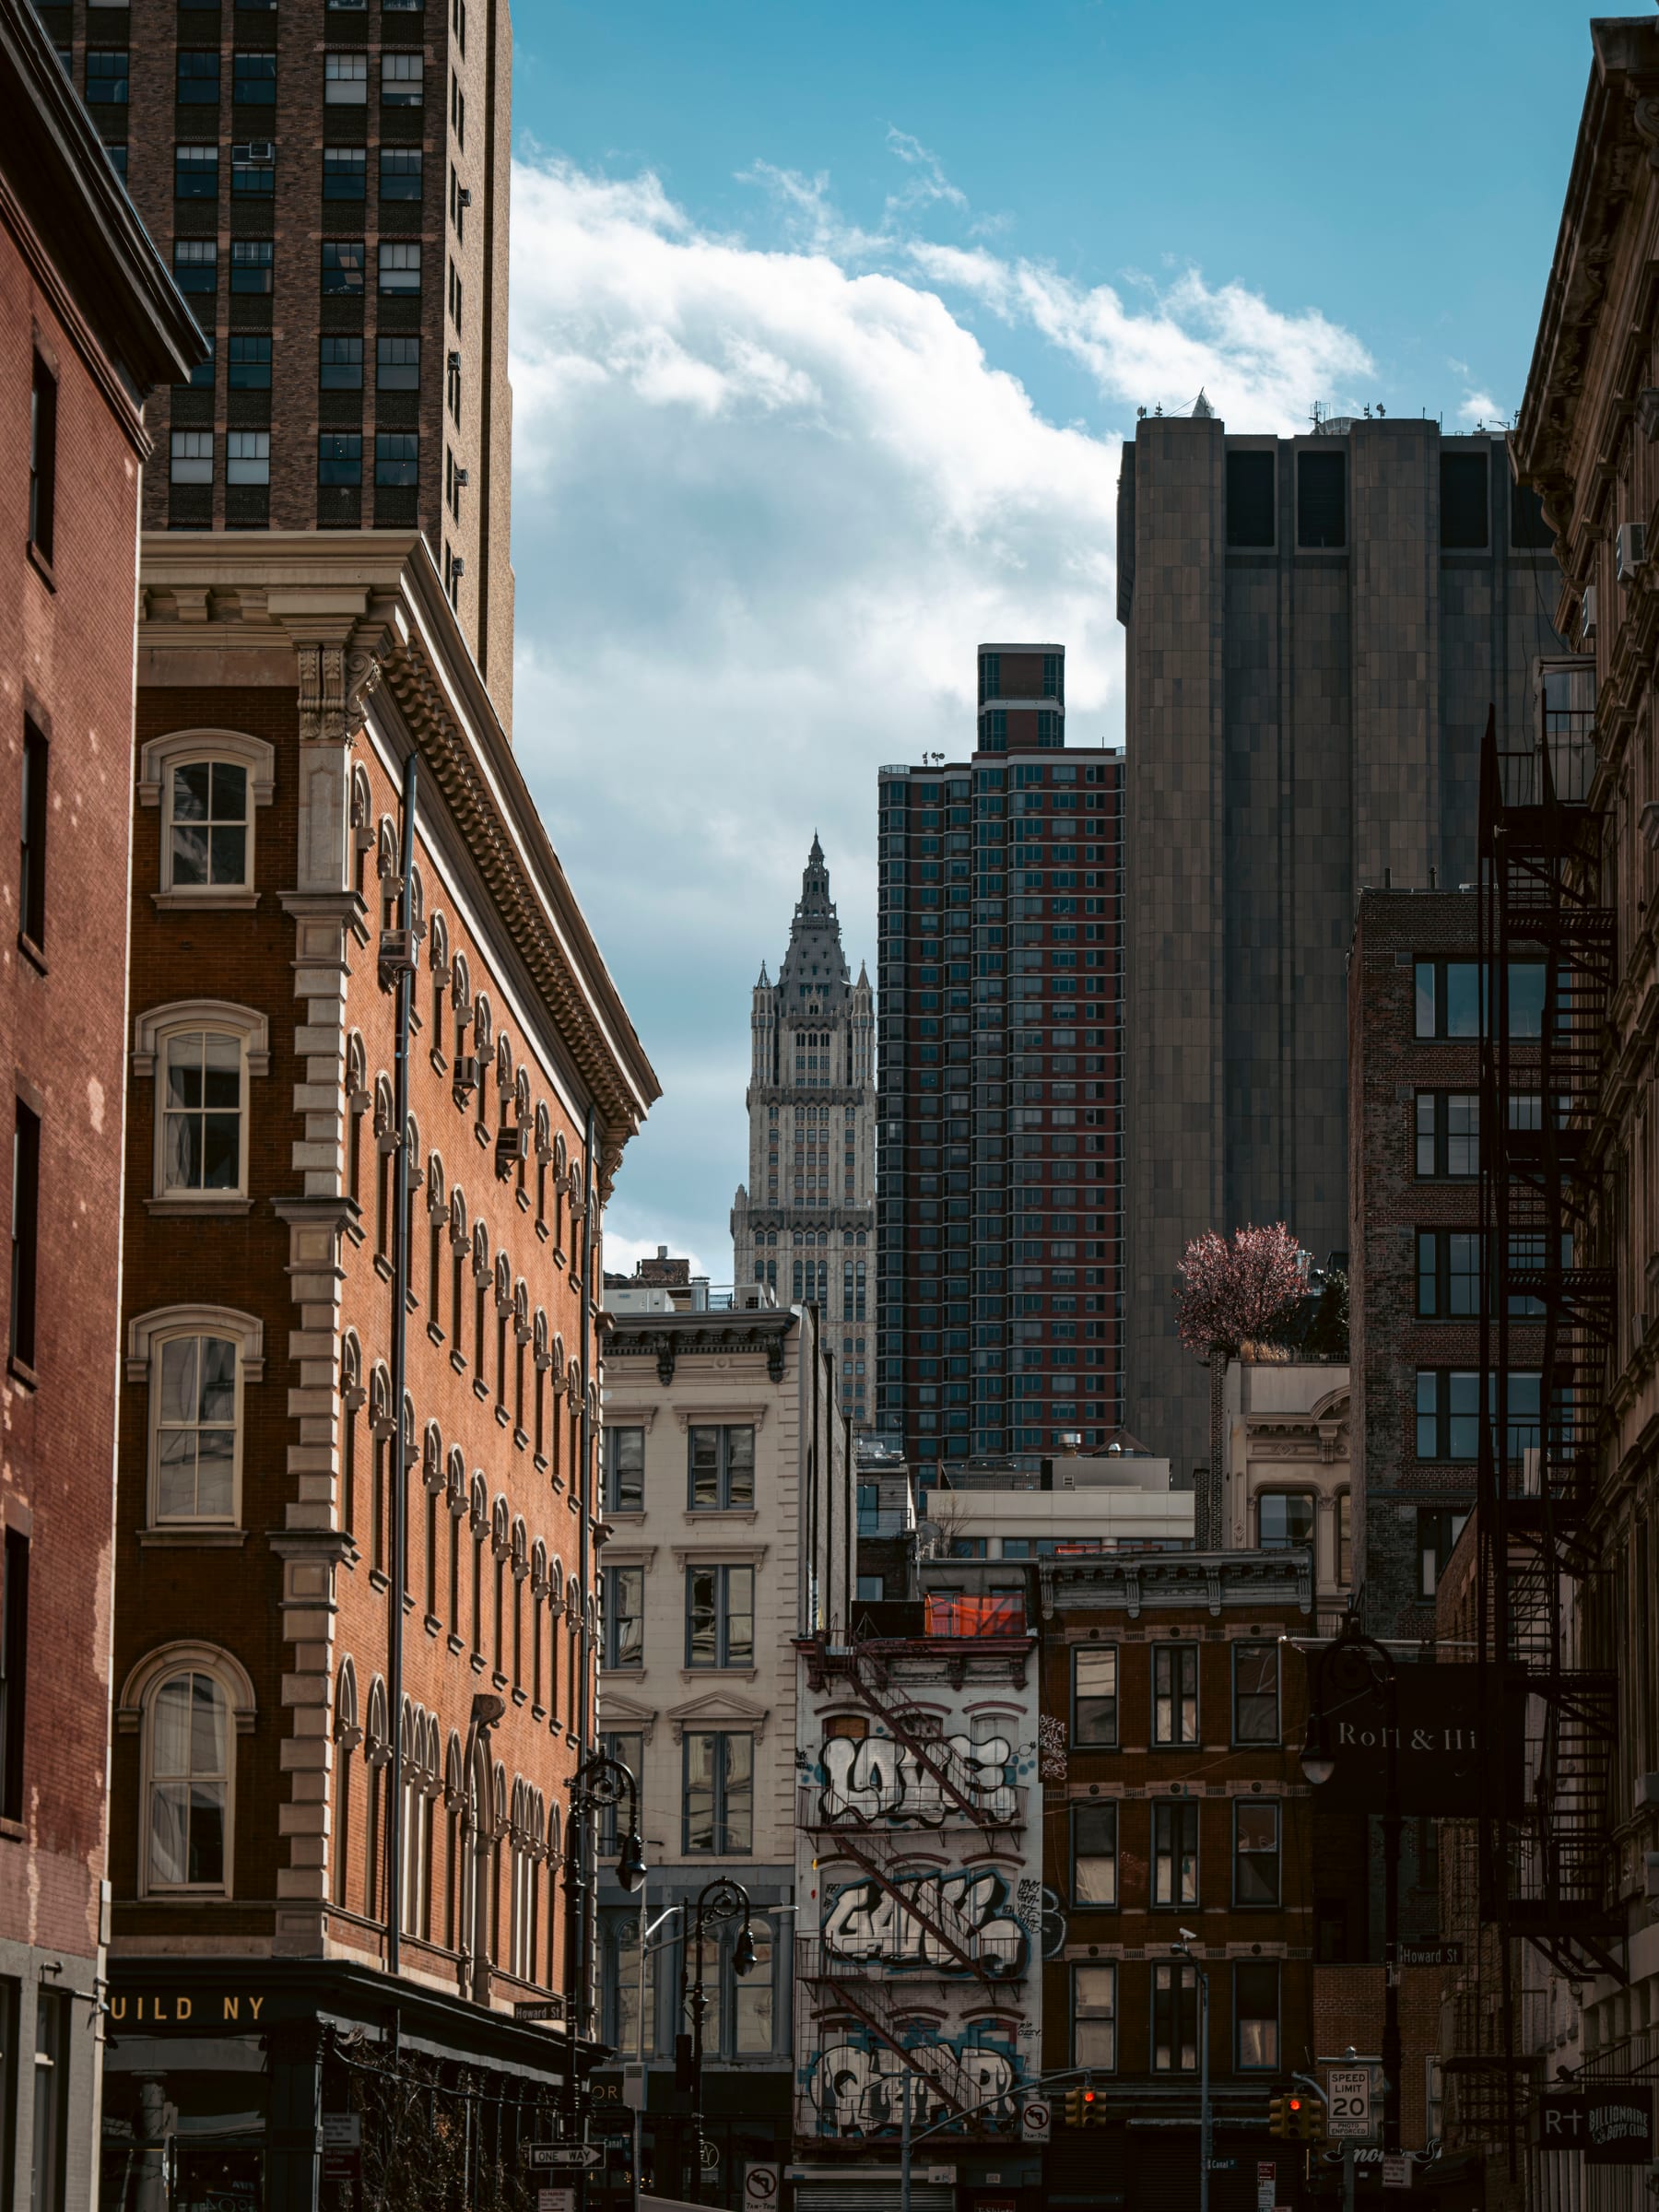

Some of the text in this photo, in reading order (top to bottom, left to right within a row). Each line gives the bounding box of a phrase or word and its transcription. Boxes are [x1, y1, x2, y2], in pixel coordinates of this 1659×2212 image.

[1410, 1728, 1438, 1751] &
[1403, 1947, 1458, 1963] Howard St
[111, 1996, 265, 2019] UILD NY
[516, 2006, 560, 2020] Howard St
[1332, 2074, 1366, 2083] SPEED
[1335, 2084, 1362, 2093] LIMIT
[1333, 2098, 1365, 2116] 20
[1588, 2104, 1649, 2132] BILLIONAIRE
[1606, 2122, 1649, 2141] BOYS CLUB
[538, 2150, 591, 2161] ONE WAY
[1211, 2159, 1229, 2169] Canal
